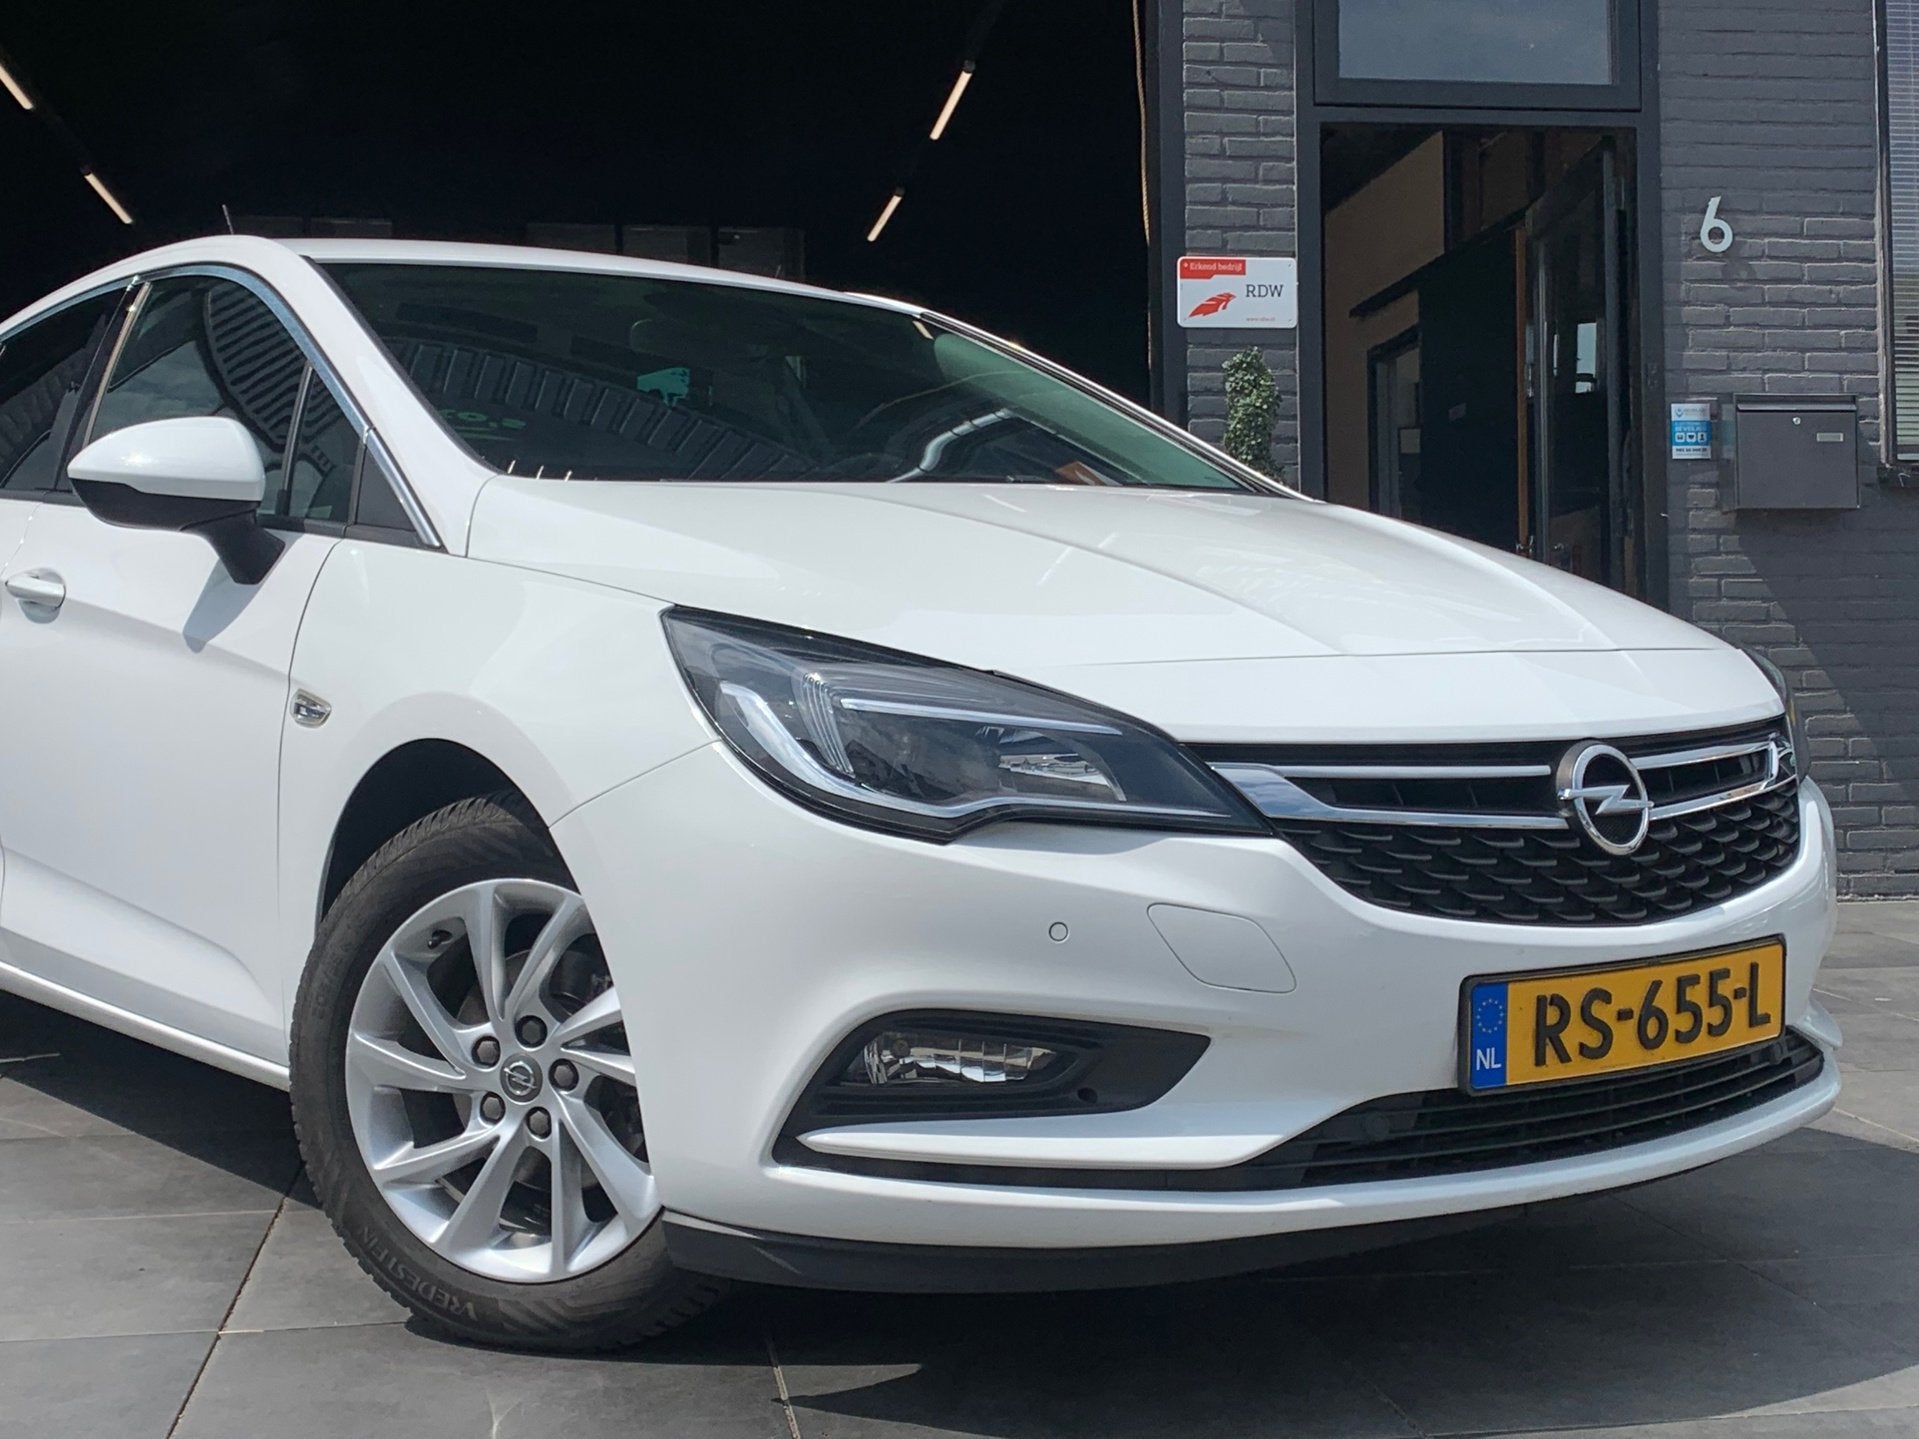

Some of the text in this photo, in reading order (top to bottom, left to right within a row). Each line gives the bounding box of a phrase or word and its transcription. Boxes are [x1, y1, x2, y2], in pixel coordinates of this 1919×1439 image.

[1700, 195, 1733, 253] 6
[1245, 284, 1284, 298] RDW
[1534, 961, 1771, 1067] RS-655-L
[1475, 1047, 1502, 1071] NL
